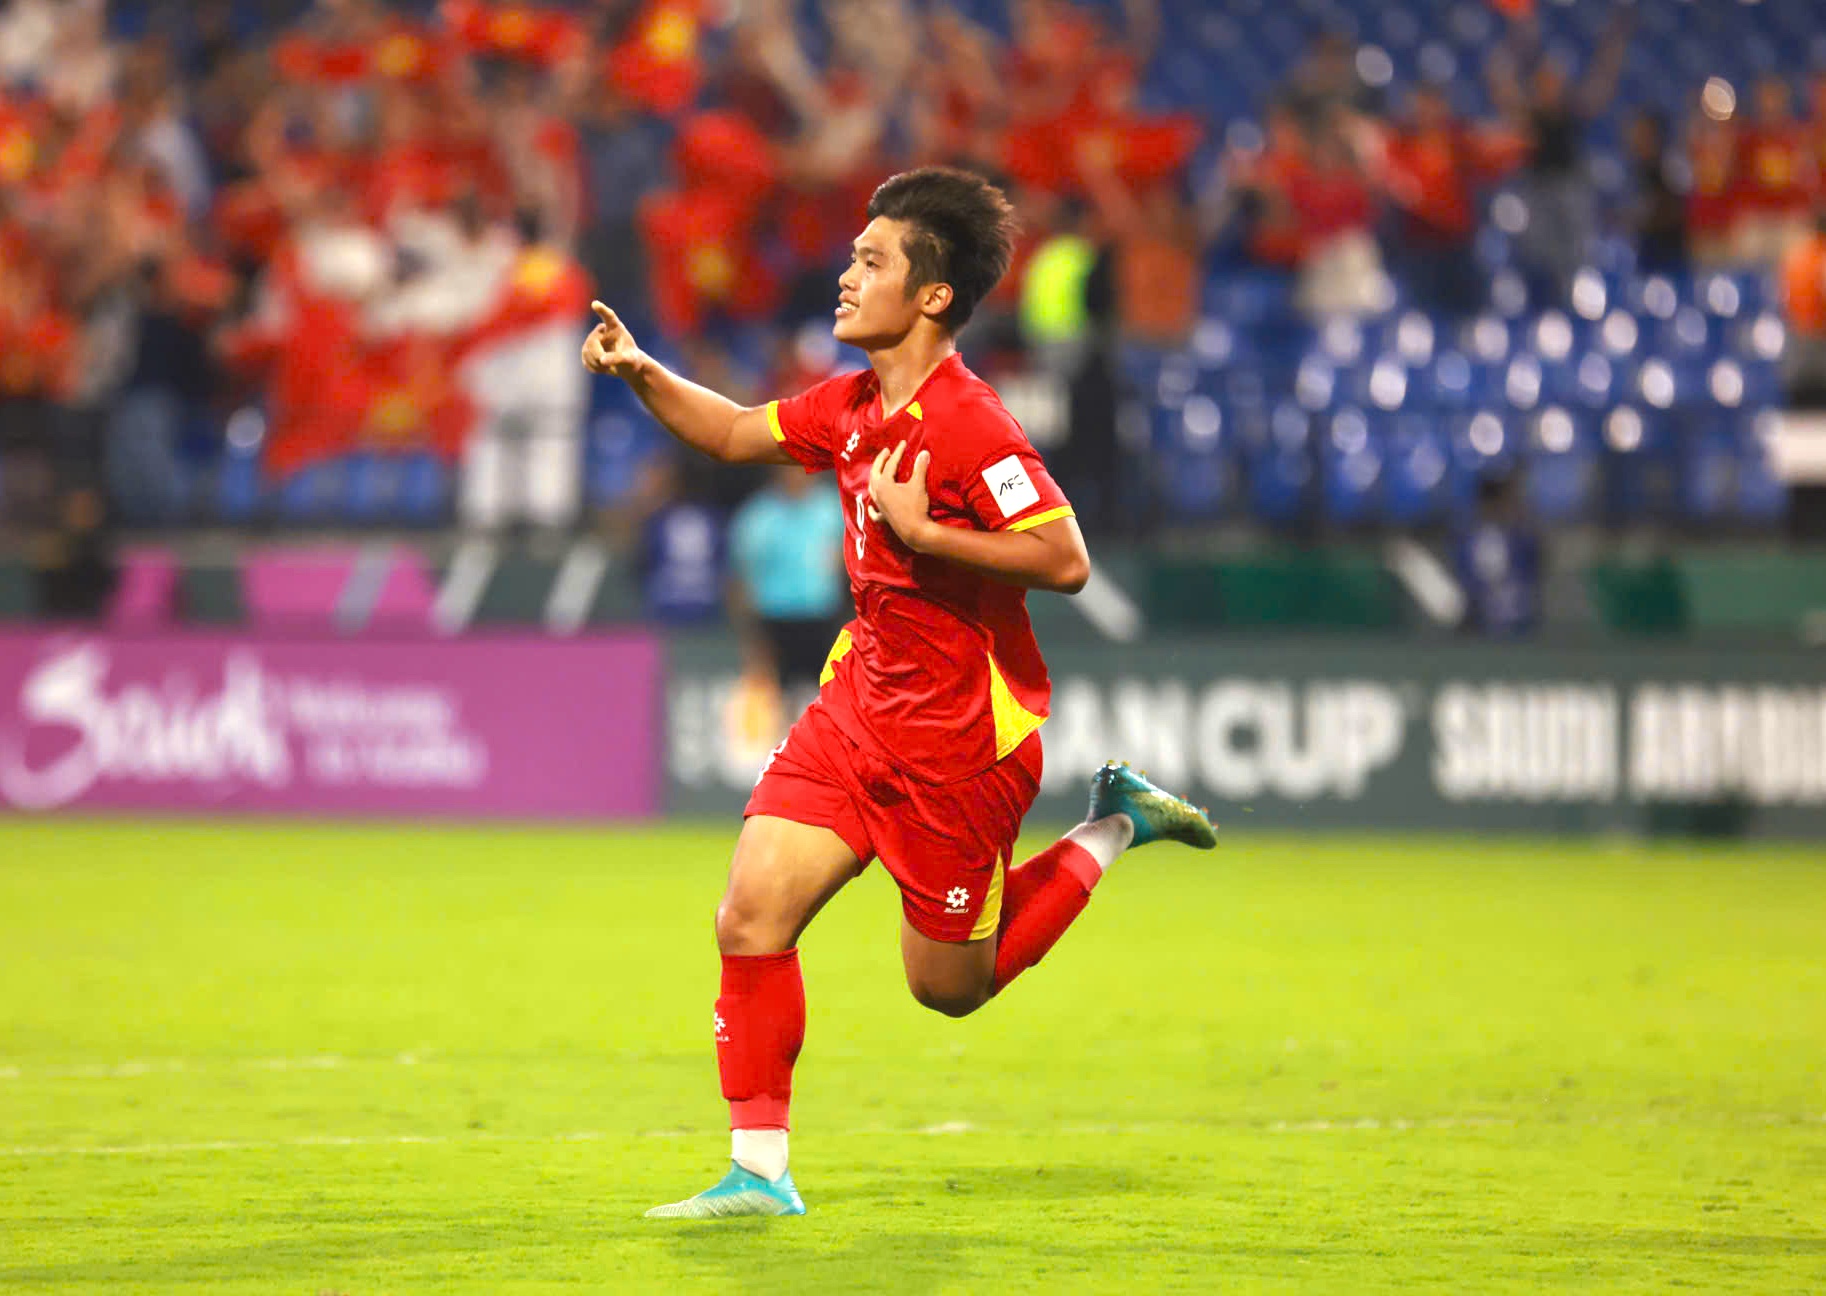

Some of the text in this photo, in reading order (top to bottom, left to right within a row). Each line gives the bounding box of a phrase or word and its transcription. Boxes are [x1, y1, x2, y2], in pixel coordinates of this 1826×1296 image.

[999, 474, 1024, 496] AFC
[855, 492, 867, 561] 9
[1200, 679, 1401, 798] CUP
